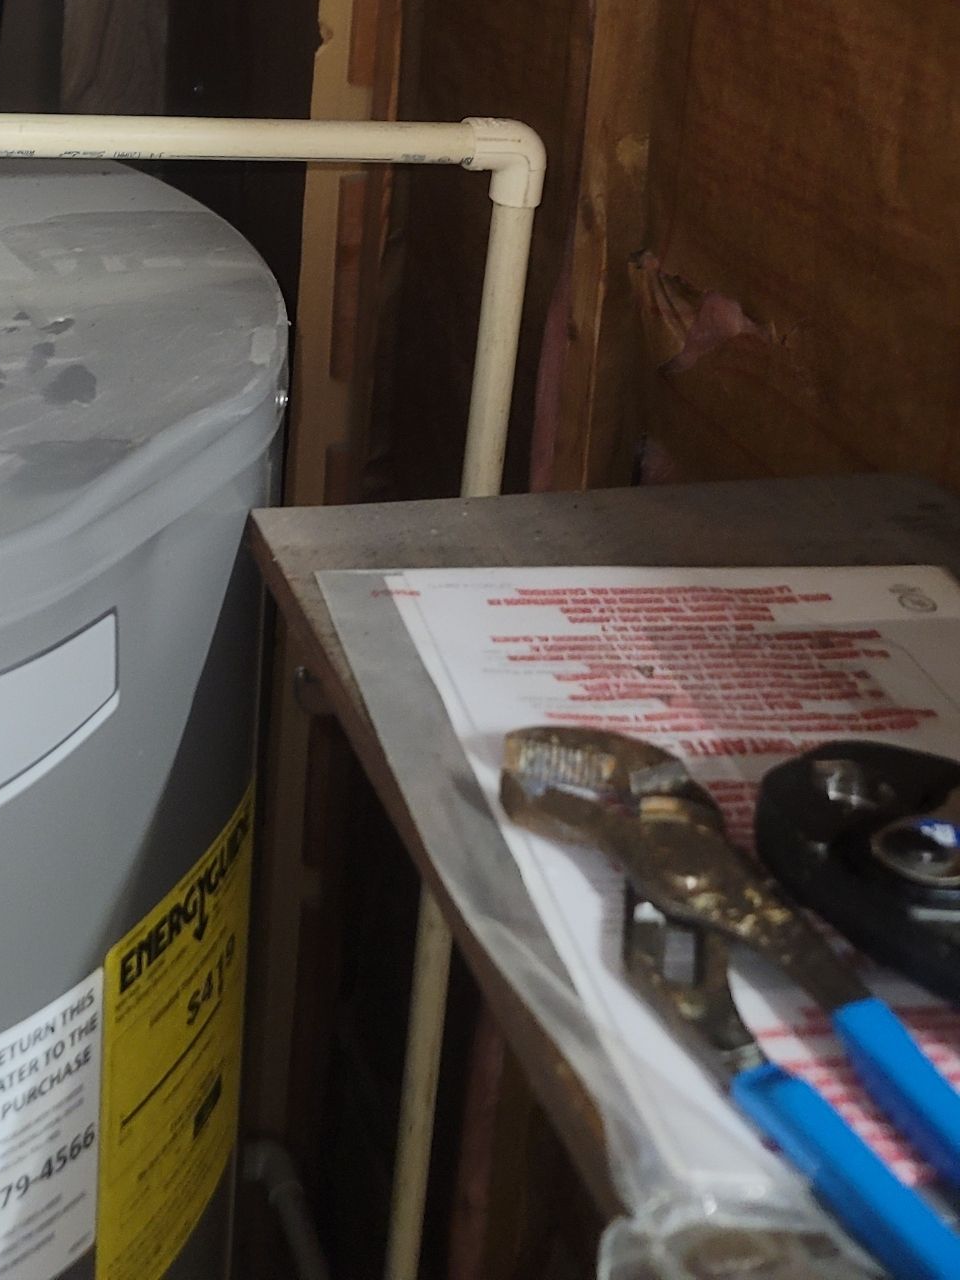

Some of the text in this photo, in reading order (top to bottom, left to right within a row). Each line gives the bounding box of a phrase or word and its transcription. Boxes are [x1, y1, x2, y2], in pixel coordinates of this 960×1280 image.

[60, 988, 95, 1026] THIS
[44, 1040, 65, 1066] TO
[69, 1012, 99, 1048] THE
[1, 1045, 92, 1120] PURCHASE
